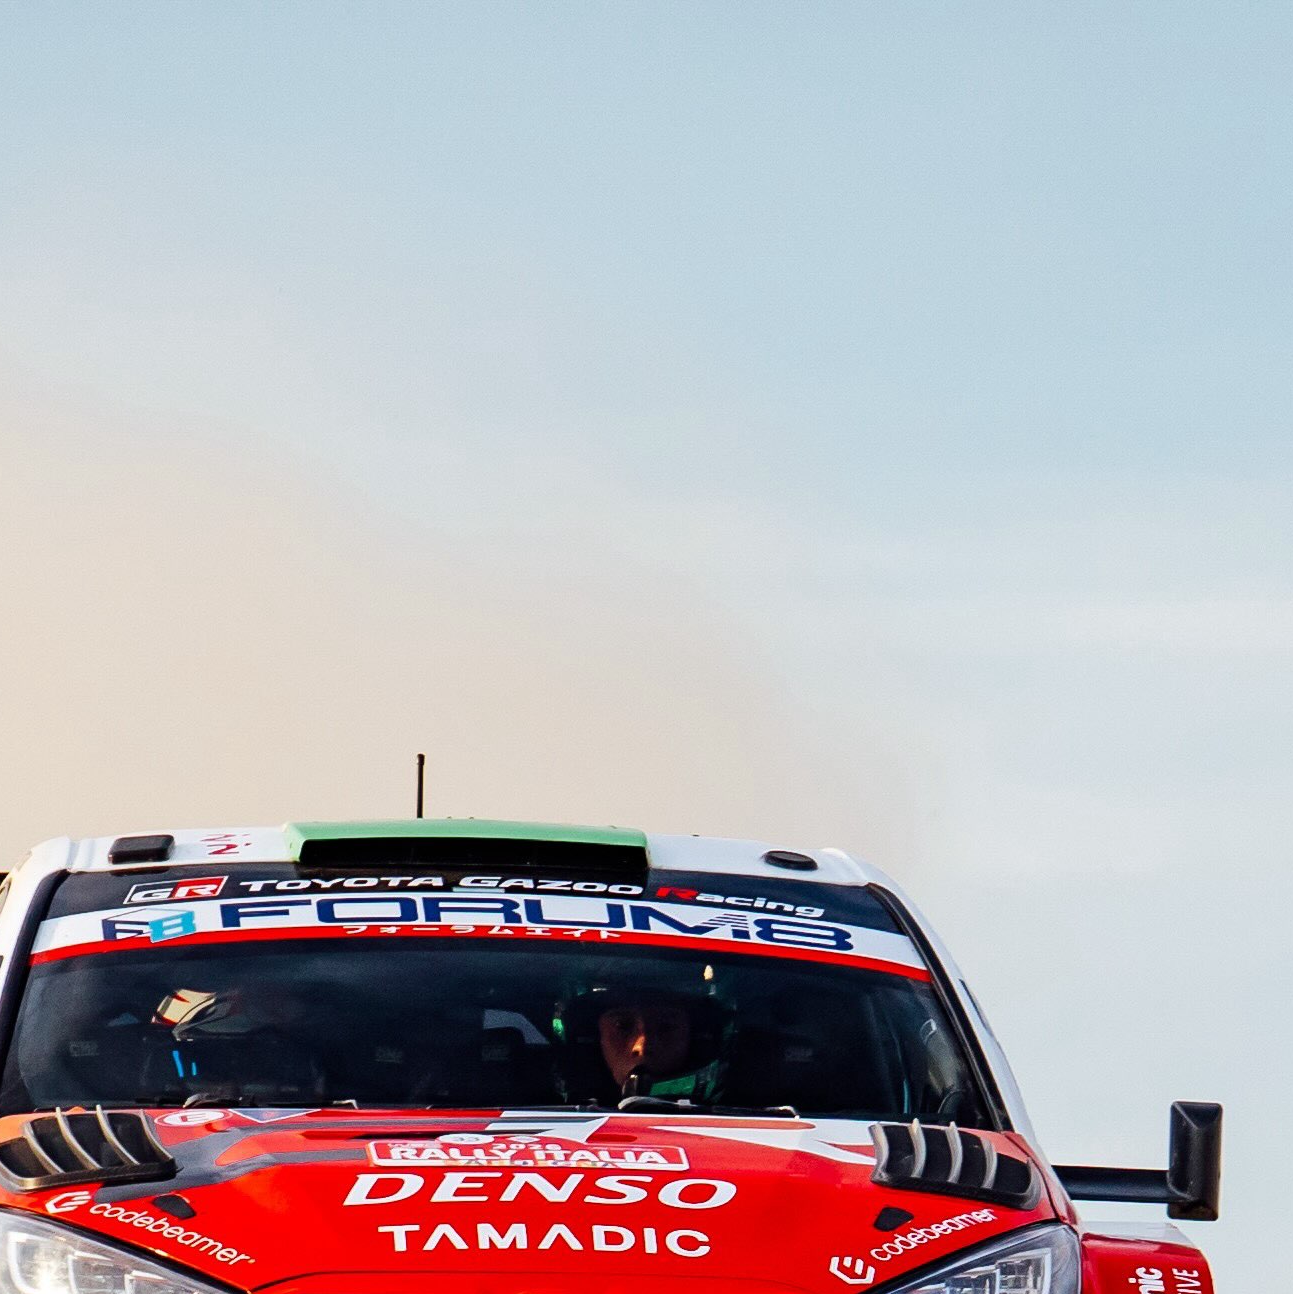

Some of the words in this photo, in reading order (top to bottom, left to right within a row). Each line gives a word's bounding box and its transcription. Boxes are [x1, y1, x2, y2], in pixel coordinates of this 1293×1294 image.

[127, 881, 221, 902] GR
[239, 876, 444, 892] TOYOTA
[459, 875, 644, 896] GAZOO
[656, 886, 825, 918] Racing
[219, 896, 854, 951] FORUM8
[342, 925, 622, 940] フォーラムエイト
[389, 1147, 519, 1161] RALLY
[533, 1149, 669, 1164] ITALIA
[343, 1172, 737, 1209] DENSO
[89, 1202, 251, 1266] codebeamer
[377, 1222, 712, 1258] TAMADIC
[869, 1207, 998, 1262] codebeamer
